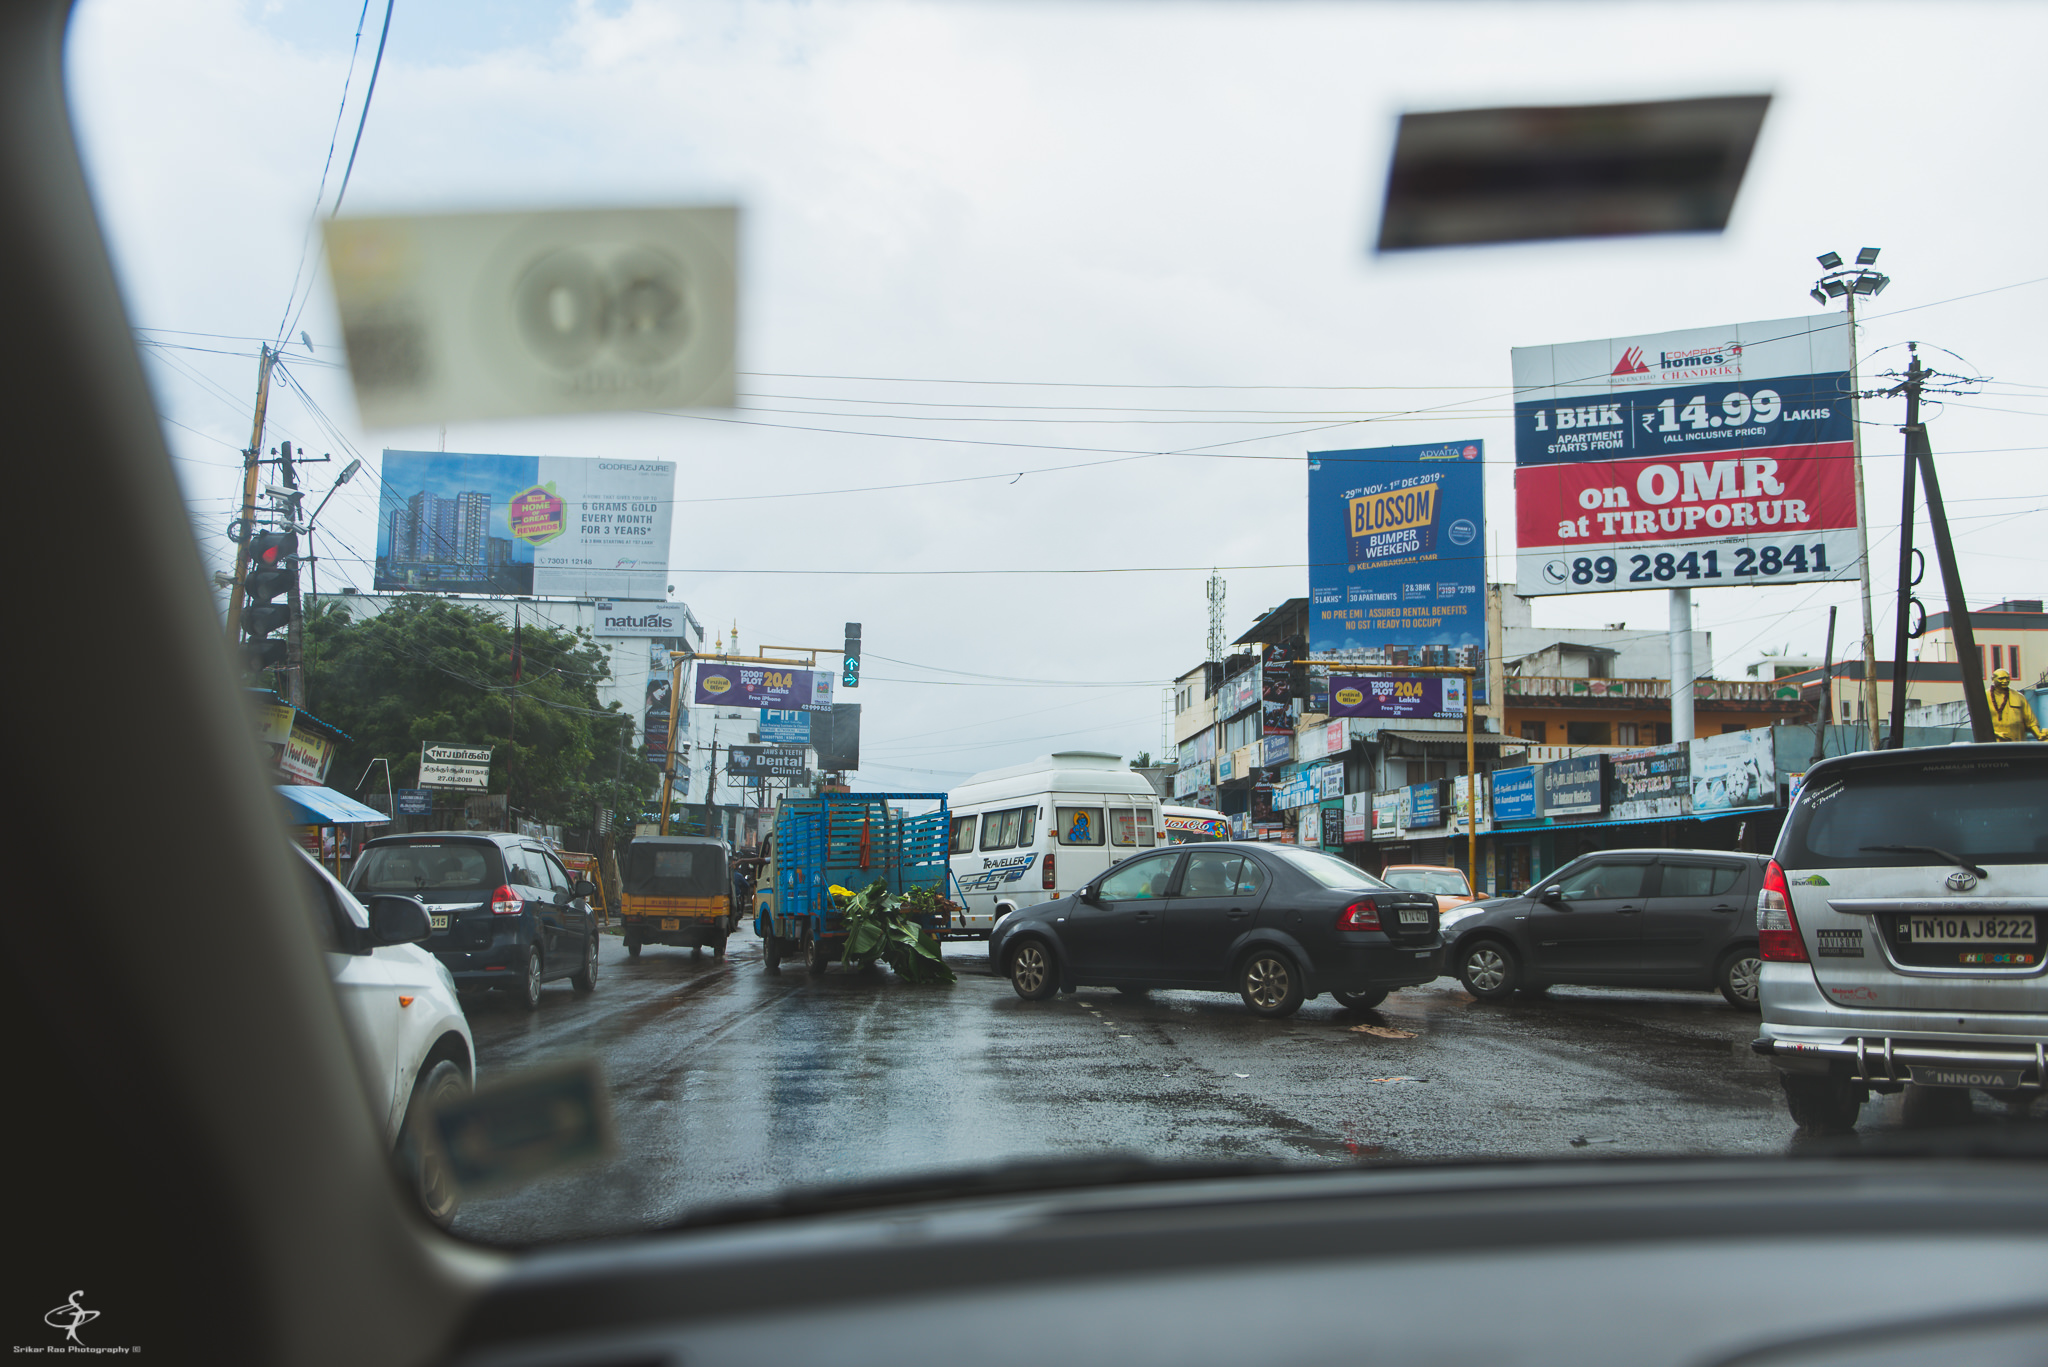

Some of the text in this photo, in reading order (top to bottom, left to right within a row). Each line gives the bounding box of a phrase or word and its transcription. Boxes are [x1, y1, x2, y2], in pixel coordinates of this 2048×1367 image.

[1666, 347, 1722, 359] COMPACT
[1660, 352, 1723, 369] homes
[1662, 366, 1742, 380] CHANDRIKA
[1535, 404, 1623, 431] 1 BHK
[1783, 408, 1830, 422] LAKHS
[1558, 430, 1623, 444] APARTMENT
[1664, 426, 1766, 444] (ALL INCLUSIVE PRICE)
[1420, 446, 1459, 458] ADVAITA
[1548, 440, 1623, 454] STARTS FROM
[1363, 484, 1383, 496] NOV
[1402, 477, 1418, 488] DEC
[1420, 472, 1440, 484] 2019
[1579, 456, 1784, 509] on OMR
[522, 502, 550, 512] HOME
[592, 502, 627, 511] GRAMS
[632, 503, 657, 512] GOLD
[1355, 490, 1429, 533] BLOSSOM
[523, 514, 549, 523] GREAT
[582, 514, 653, 524] EVERY MONTH
[1558, 499, 1810, 538] at TIRUPORUR
[517, 524, 558, 534] REWARDS
[581, 526, 600, 534] FOR
[604, 526, 610, 534] 3
[1370, 530, 1416, 547] BUMPER
[1366, 541, 1420, 558] WEEKEND
[1572, 542, 1830, 585] 89 2841 2841
[1359, 593, 1397, 601] APARTMENTS
[1322, 606, 1467, 620] NO PRE EMI ASSURED RENTAL BENEFITS
[605, 614, 672, 627] naturals
[1346, 618, 1442, 630] NO GST READY TO OCCUPY
[288, 743, 318, 768] Food Corner
[756, 755, 802, 767] Dental
[1651, 760, 1664, 773] DIESEL
[1627, 775, 1671, 798] ENFIELD
[1521, 793, 1533, 802] Clinic
[983, 856, 1024, 869] TRAVELLER
[1820, 938, 1862, 947] ADVISORY
[1959, 953, 2034, 964] THE DOCTOR
[1937, 1073, 2004, 1085] INNOVA
